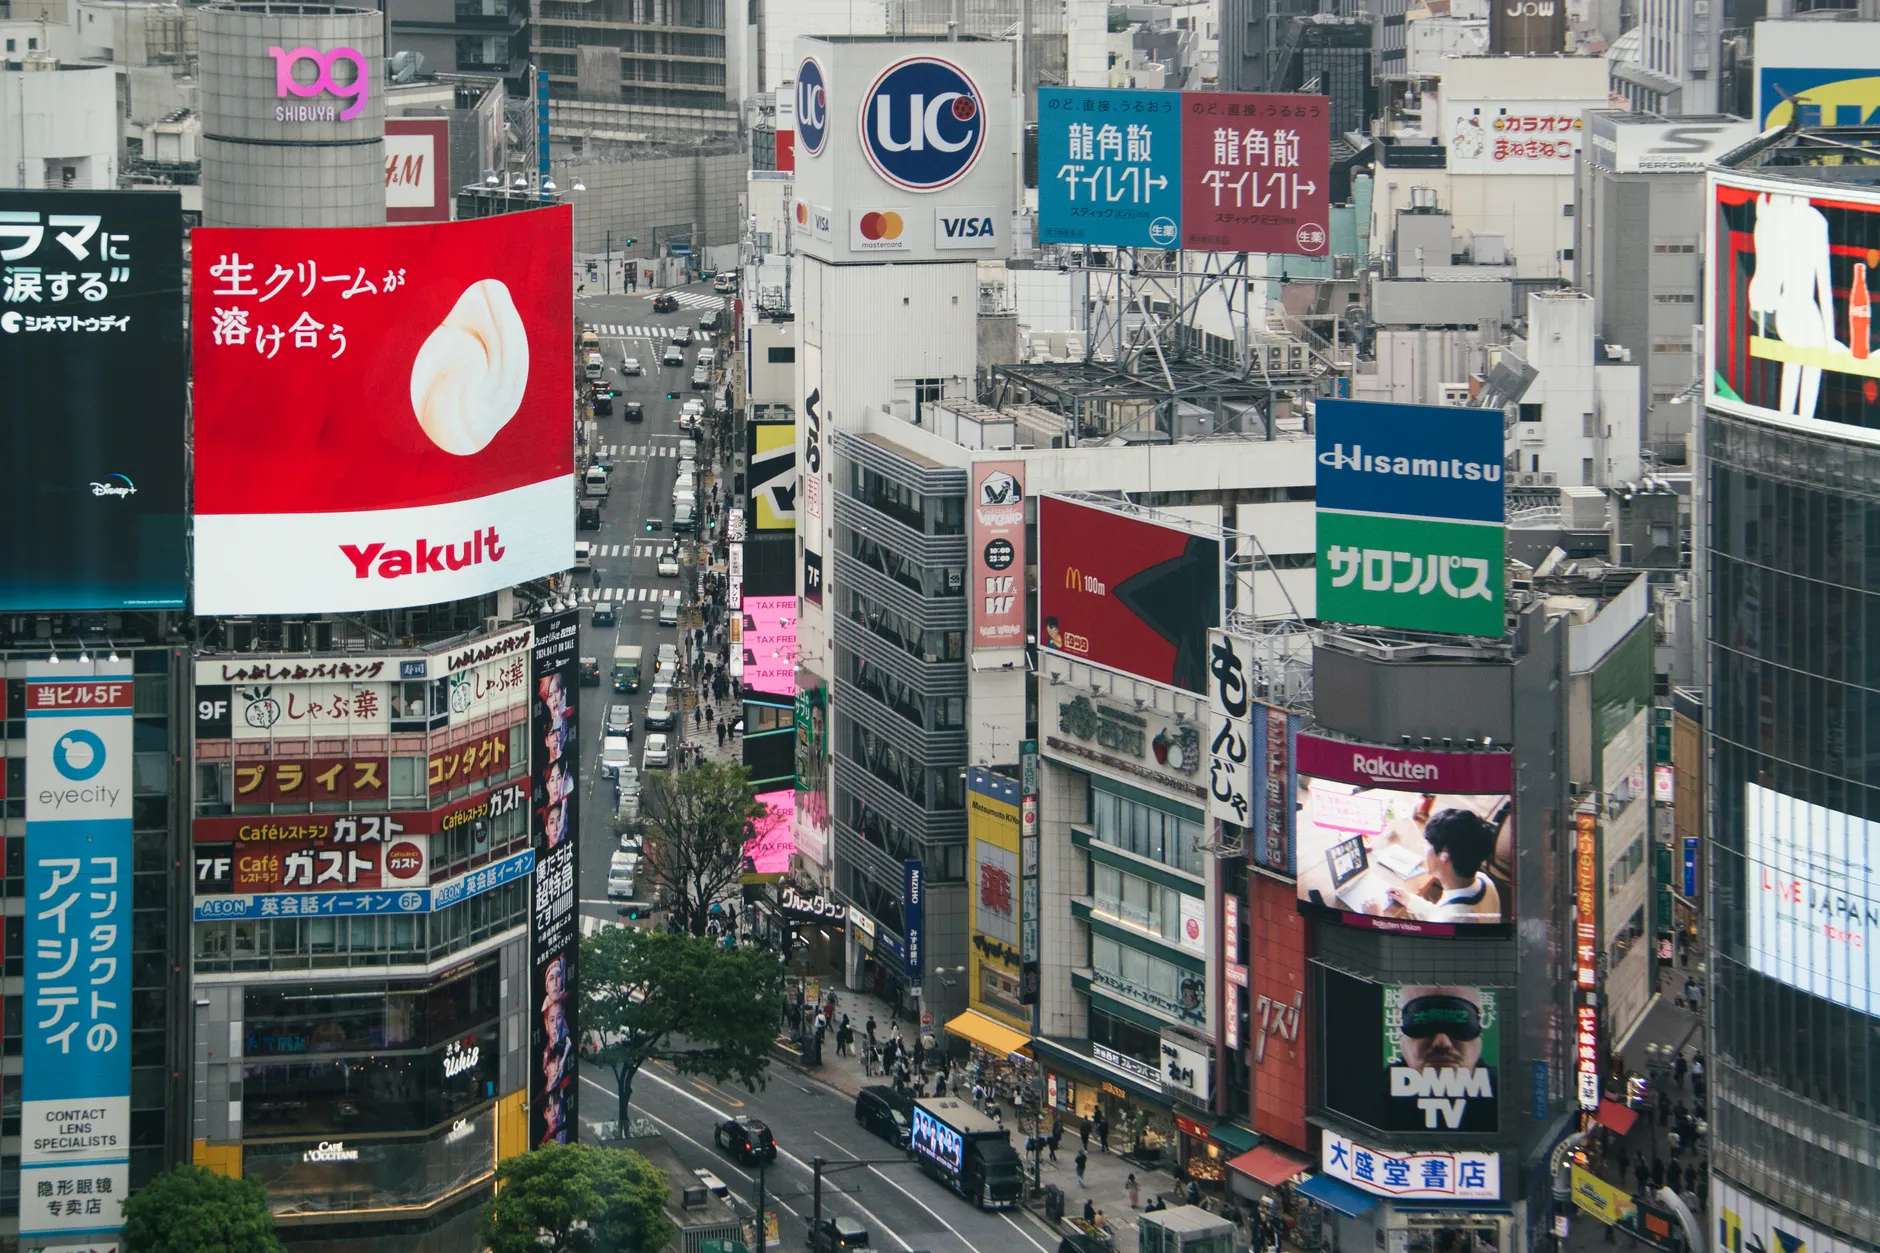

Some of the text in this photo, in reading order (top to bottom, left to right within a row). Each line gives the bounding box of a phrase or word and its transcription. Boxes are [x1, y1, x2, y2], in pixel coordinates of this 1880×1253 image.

[268, 46, 369, 121] 109
[275, 105, 335, 121] SHIBUYA
[1049, 98, 1173, 113] のど、直接、うるおう
[1192, 104, 1320, 118] のど、直接、うるおう
[876, 91, 974, 153] UC
[1504, 115, 1574, 133] カラオケ
[1068, 122, 1153, 162] 龍角散
[1213, 128, 1300, 167] 龍角散
[1493, 138, 1573, 160] まねきねこ
[1070, 207, 1113, 218] スティック
[1215, 213, 1259, 224] スティック
[939, 217, 995, 238] VISA
[210, 253, 406, 302] 生クリームが
[211, 306, 348, 360] 溶け合う
[1318, 443, 1500, 482] Hisamitsu
[338, 526, 506, 580] Yakult
[808, 564, 820, 587] 7F
[1327, 544, 1493, 602] サロンパス
[1084, 575, 1105, 596] 100m
[756, 601, 775, 609] TAX
[222, 661, 384, 681] しゃぶしゃぶバイキング
[403, 662, 425, 675] 寿司
[37, 685, 123, 706] 当ビル5F
[288, 689, 378, 720] しゃぶ葉
[199, 701, 227, 720] 9F
[429, 736, 506, 786] コンタクト
[1353, 753, 1439, 780] Rakuten
[236, 763, 382, 794] プライス
[39, 785, 120, 809] eyecity
[490, 785, 525, 819] ガスト
[972, 800, 1005, 820] Matsumoto
[333, 817, 403, 843] ガスト
[196, 858, 231, 881] 7F
[239, 850, 373, 886] Café ガスト
[390, 859, 420, 869] ガスト
[466, 855, 533, 895] 英会話イーオン
[241, 873, 278, 883] レストラン
[911, 869, 919, 904] MIZUHO
[203, 895, 419, 915] AEON 英会話イーオン 6F
[782, 887, 846, 919] グルメタウン
[1809, 887, 1879, 929] JAPAN
[1372, 920, 1422, 932] Rakuten Vision
[37, 858, 81, 1054] アイシティ
[87, 857, 118, 1052] コンタクトの
[1390, 1067, 1493, 1097] DMM
[46, 1109, 106, 1122] CONTACT
[1417, 1098, 1466, 1129] TV
[59, 1123, 92, 1135] LENS
[34, 1135, 117, 1150] SPECIALISTS
[303, 1150, 358, 1163] L'OCCITANE
[1330, 1140, 1486, 1188] 大盛堂書店
[37, 1178, 113, 1197] 隐形眼镜
[46, 1198, 102, 1217] 专卖店
